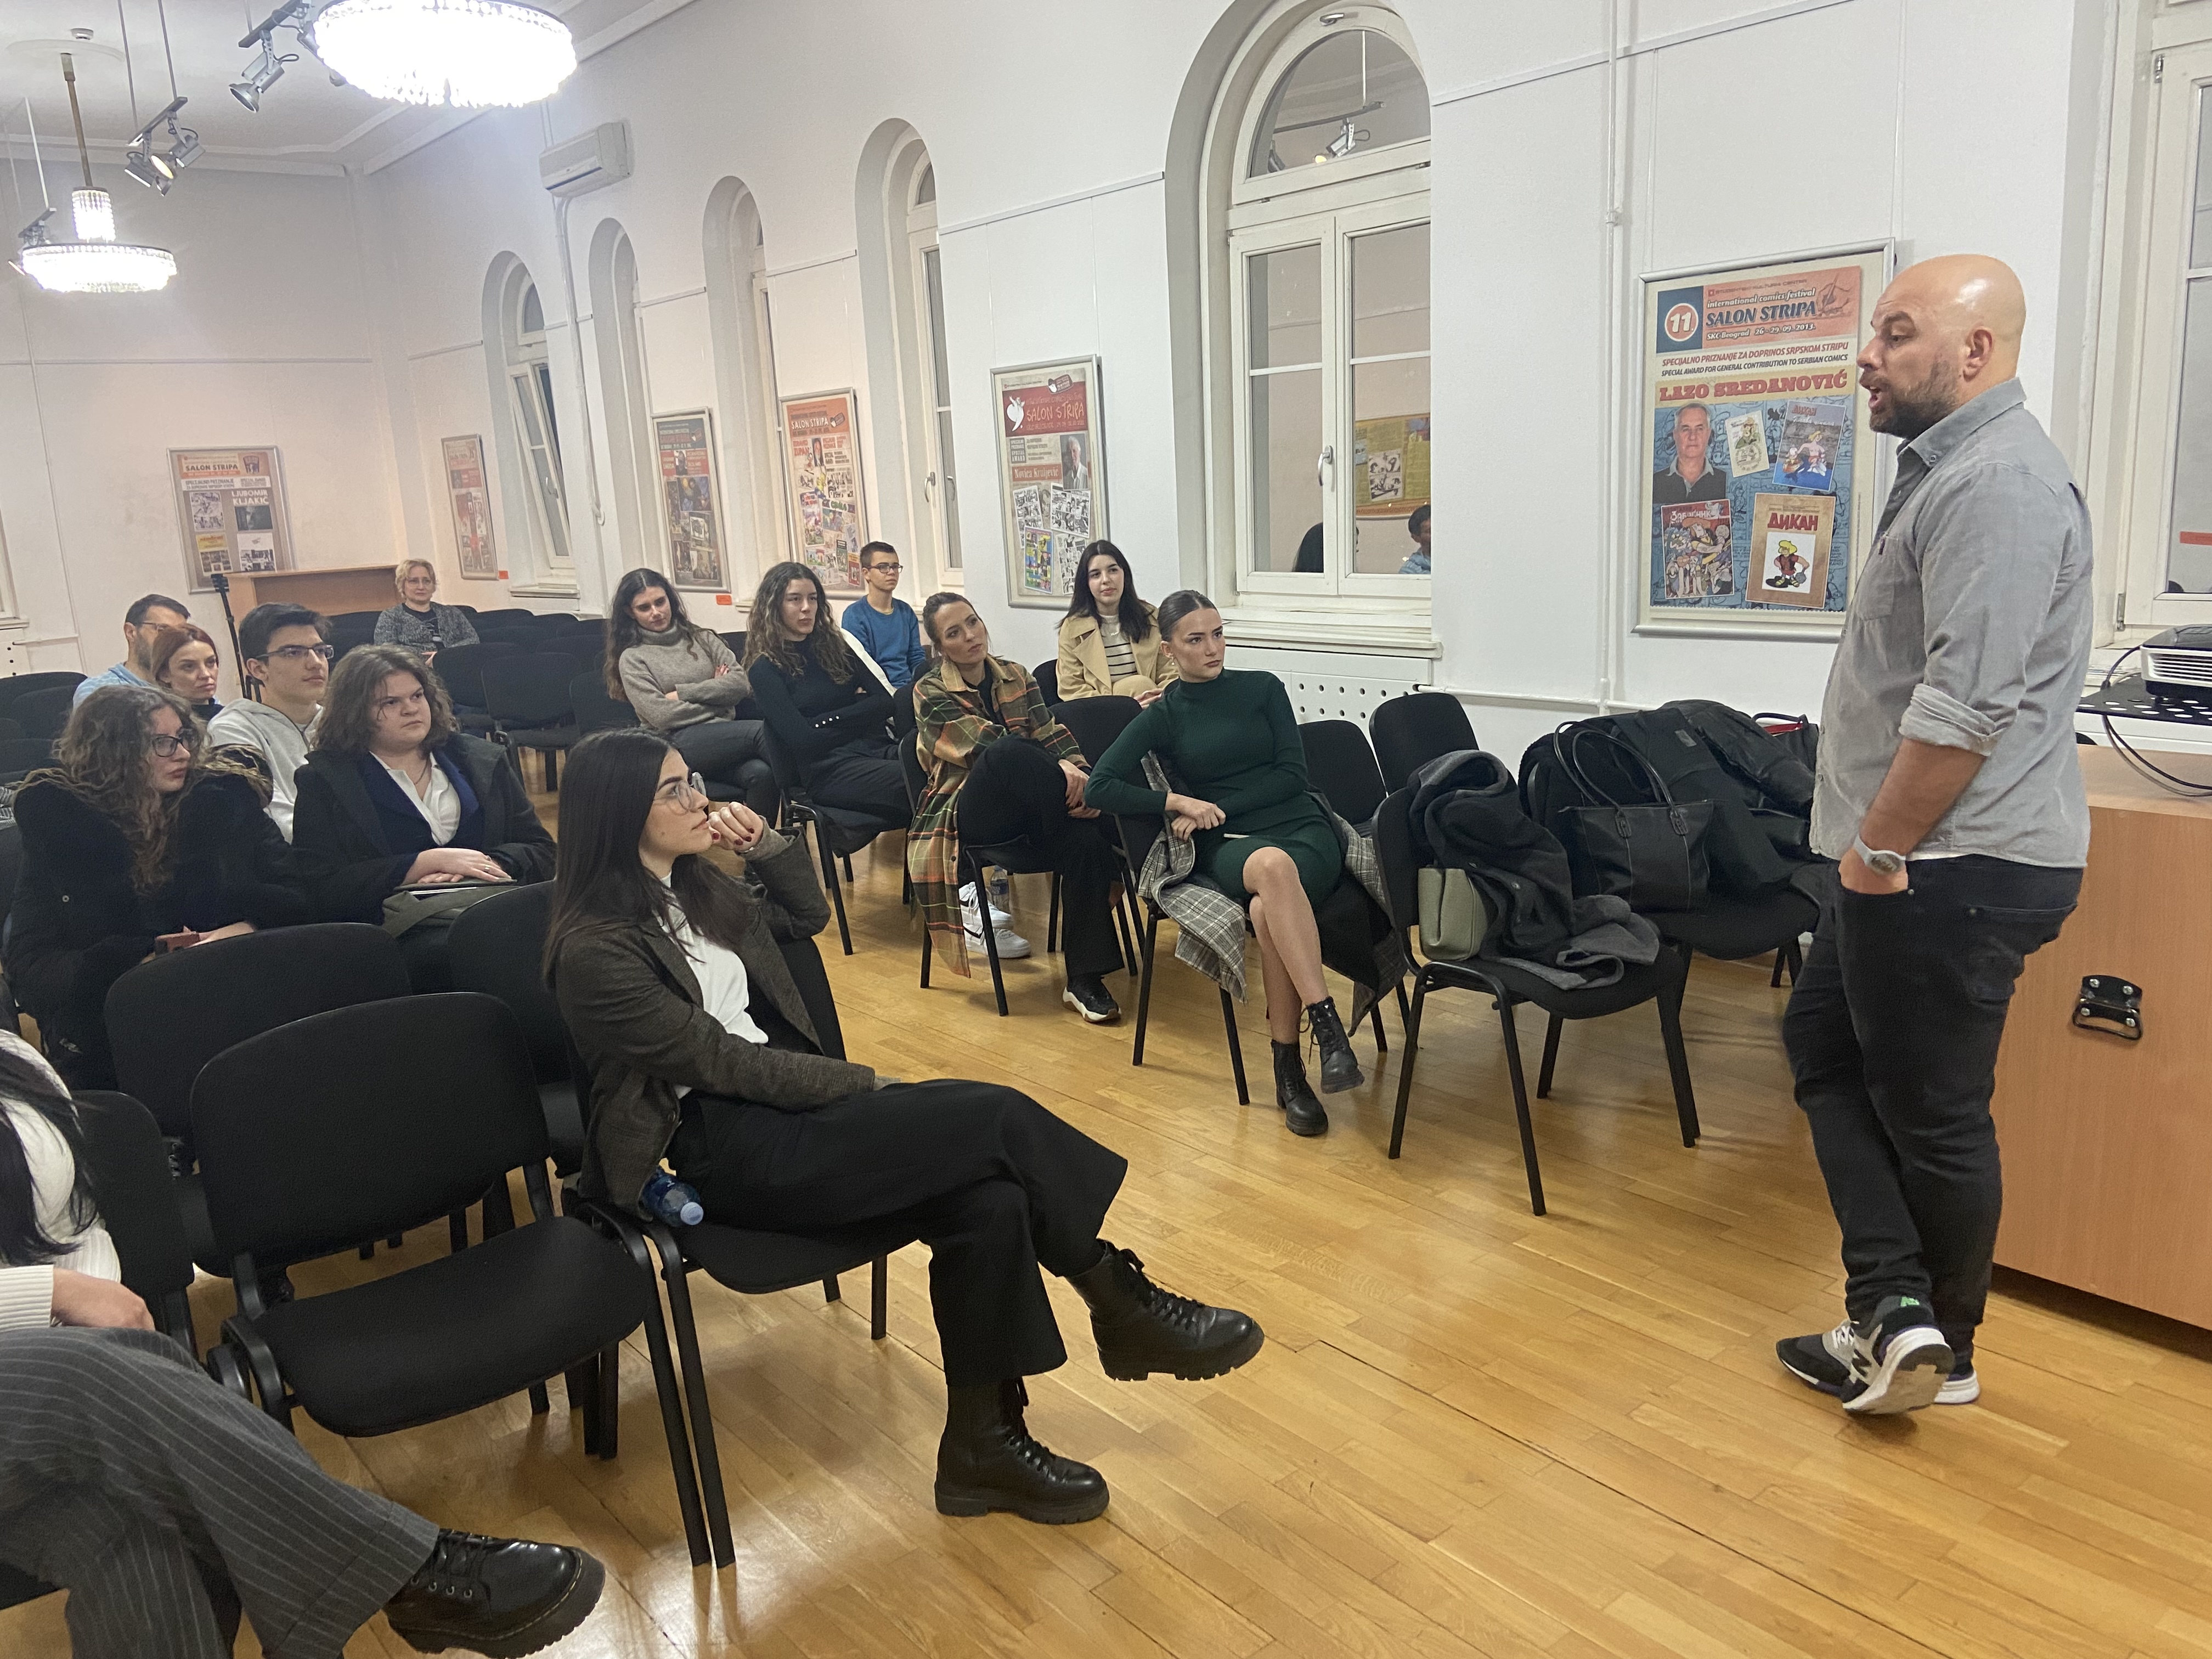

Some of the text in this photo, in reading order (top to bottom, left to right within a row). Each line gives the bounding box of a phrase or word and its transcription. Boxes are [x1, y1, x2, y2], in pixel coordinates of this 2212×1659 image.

[1707, 287, 1816, 308] international comics festival
[1671, 312, 1694, 332] 11.
[1706, 301, 1816, 328] SALON STRIPA
[1707, 332, 1719, 340] SKC
[1722, 329, 1750, 340] Beograd
[1755, 328, 1764, 336] 26
[1662, 356, 1700, 367] SPECIJALNO
[1701, 352, 1737, 364] PRIZNANJE
[1748, 348, 1785, 358] DOPRINOS
[1786, 344, 1820, 355] SRPSKOM
[1821, 342, 1849, 352] STRIPU
[1717, 363, 1742, 372] GENERAL
[1743, 359, 1787, 369] CONTRIBUTION
[1797, 356, 1824, 364] SERBIAN
[1824, 354, 1848, 362] COMICS
[1660, 369, 1847, 401] LAZO SREDANOVIĆ
[791, 417, 829, 430] SALON STRIPA
[1026, 406, 1053, 422] SALON
[1014, 469, 1032, 478] Novica
[1767, 512, 1819, 531] ДИКАН
